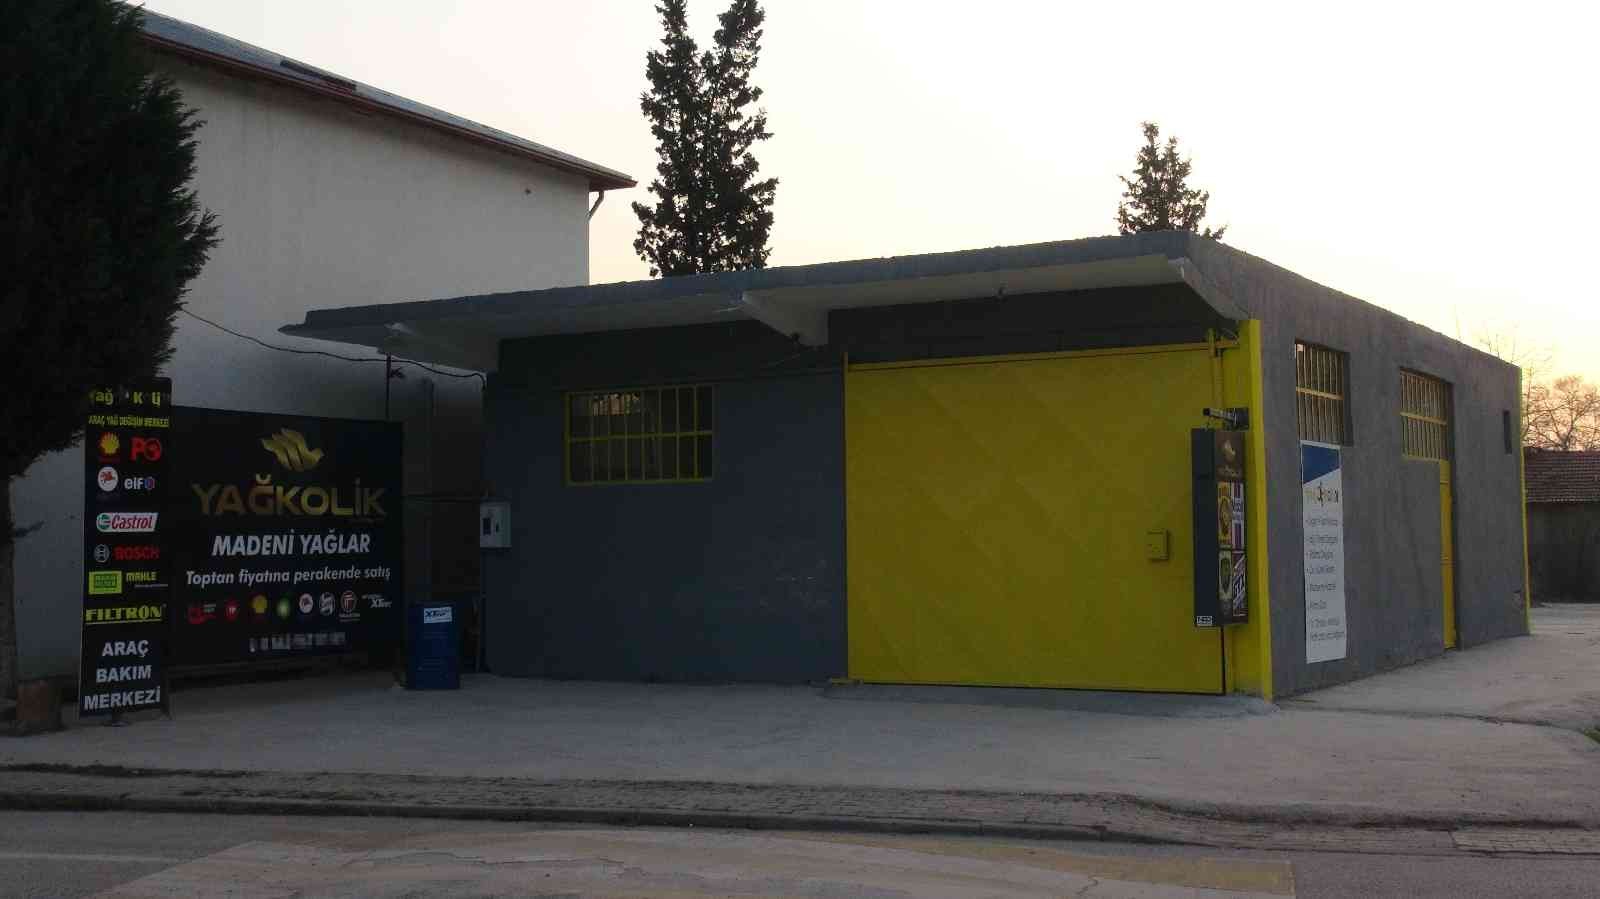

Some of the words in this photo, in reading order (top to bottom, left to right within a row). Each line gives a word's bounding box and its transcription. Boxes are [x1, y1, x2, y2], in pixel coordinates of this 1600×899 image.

[88, 415, 105, 427] ARAÇ
[191, 472, 387, 516] YAĞKOLİK
[111, 514, 154, 530] Castrol
[113, 545, 160, 560] BOSCH
[211, 530, 295, 557] MADENİ
[299, 529, 371, 556] YAĞLAR
[185, 570, 235, 590] Toptan
[238, 567, 290, 588] fiyatına
[293, 564, 361, 585] perakende
[363, 565, 391, 582] satış
[86, 605, 162, 622] FILTRON
[102, 639, 150, 658] ARAÇ
[95, 664, 152, 683] BAKIM
[84, 685, 161, 711] MERKEZİ
